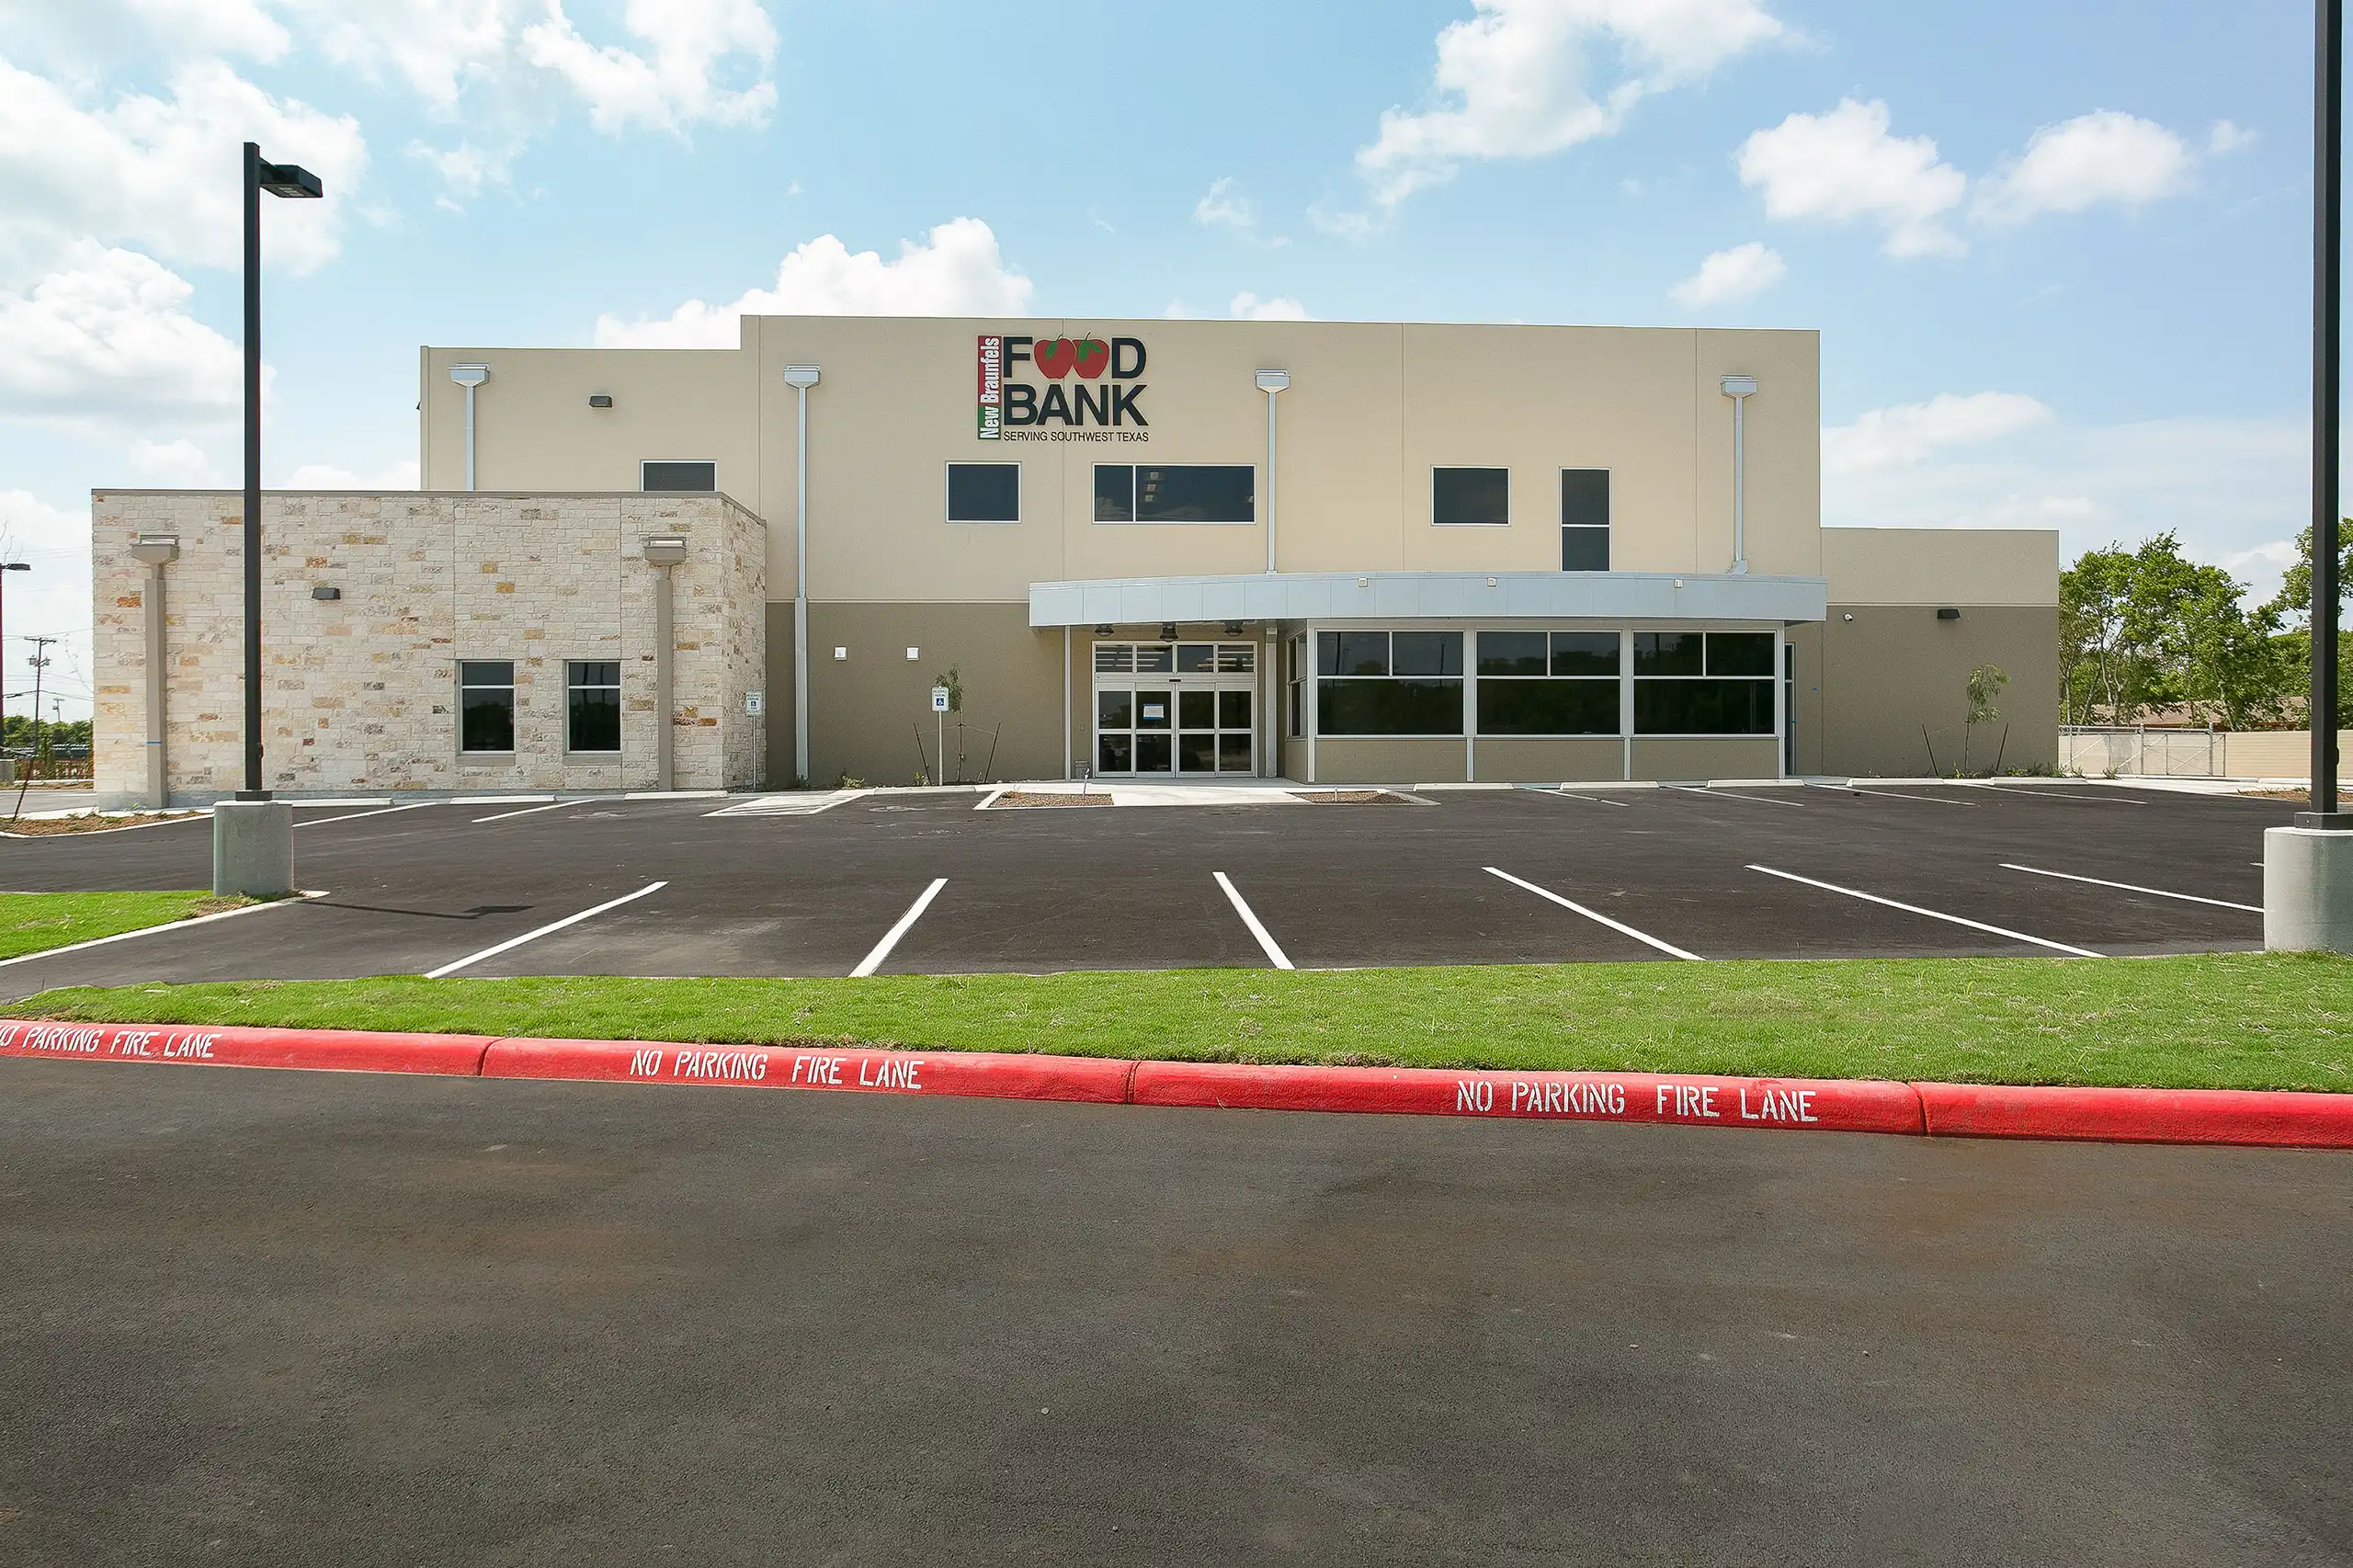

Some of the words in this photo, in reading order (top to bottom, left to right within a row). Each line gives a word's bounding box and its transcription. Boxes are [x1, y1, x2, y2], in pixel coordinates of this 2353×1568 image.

[980, 337, 1000, 403] Braunfels
[980, 406, 999, 438] New
[1004, 384, 1149, 426] BANK
[1003, 431, 1047, 441] SERVING
[1051, 431, 1115, 441] SOUTHWEST
[1117, 431, 1149, 442] TEXAS
[0, 1025, 20, 1047] O
[22, 1026, 106, 1052] PARKING
[109, 1030, 161, 1055] FIRE
[164, 1032, 223, 1057] LANE
[630, 1049, 663, 1076] NO
[673, 1051, 768, 1080] PARKING
[791, 1056, 847, 1085] FIRE
[858, 1059, 926, 1089] LANE
[1457, 1080, 1494, 1111] NO
[1511, 1082, 1625, 1114] PARKING
[1656, 1085, 1720, 1117] FIRE
[1740, 1087, 1818, 1121] LANE
